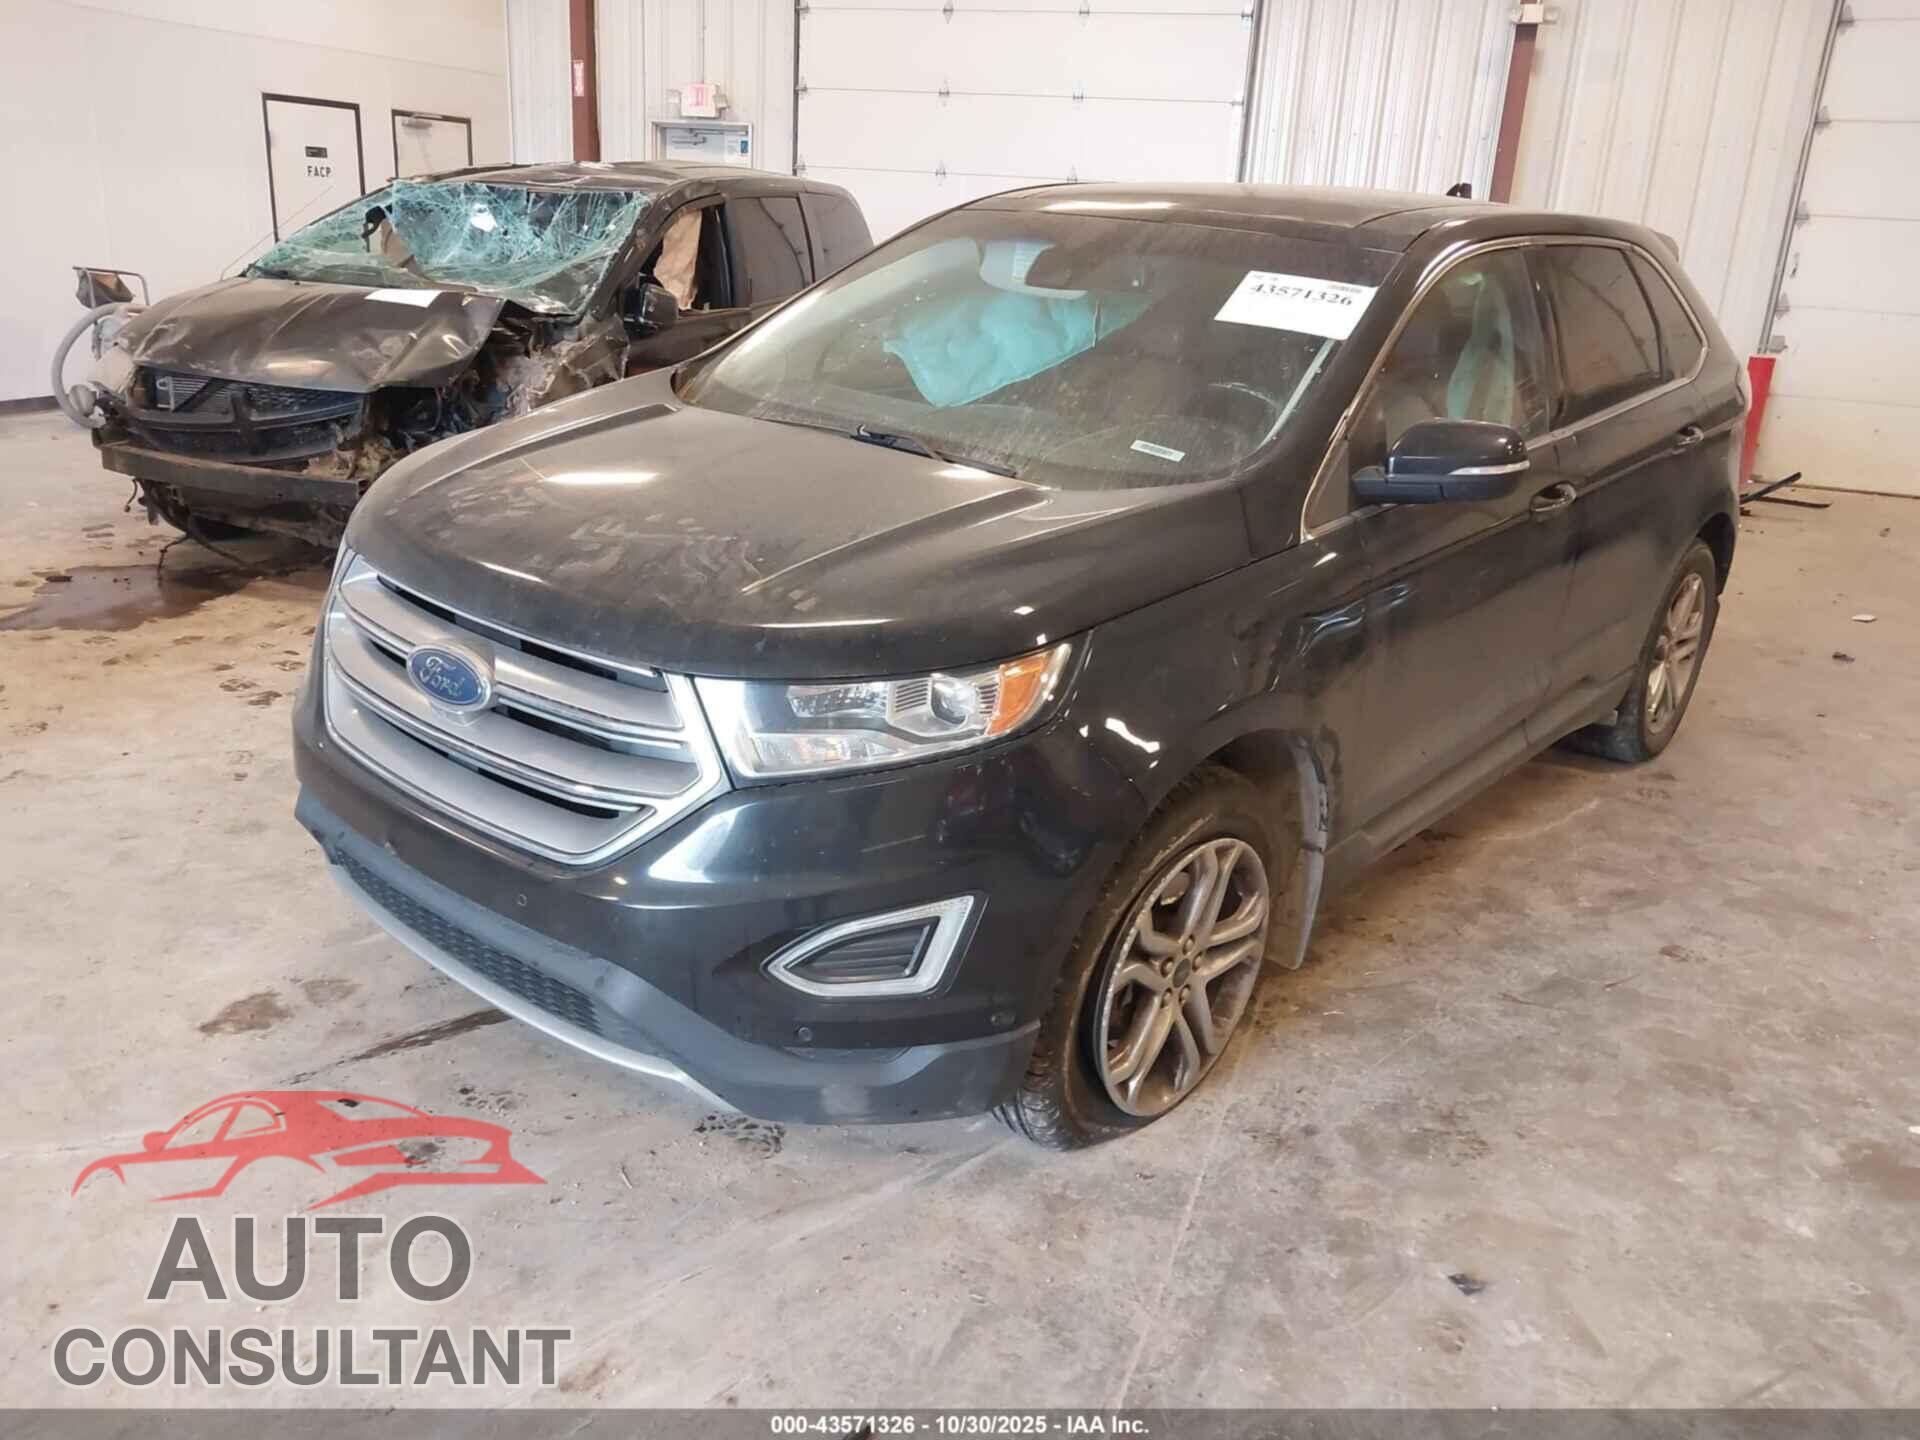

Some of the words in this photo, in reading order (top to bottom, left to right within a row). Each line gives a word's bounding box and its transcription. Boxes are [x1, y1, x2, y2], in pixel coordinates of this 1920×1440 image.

[307, 165, 332, 178] FACP
[1250, 283, 1353, 306] 43571326
[418, 656, 466, 697] Ford
